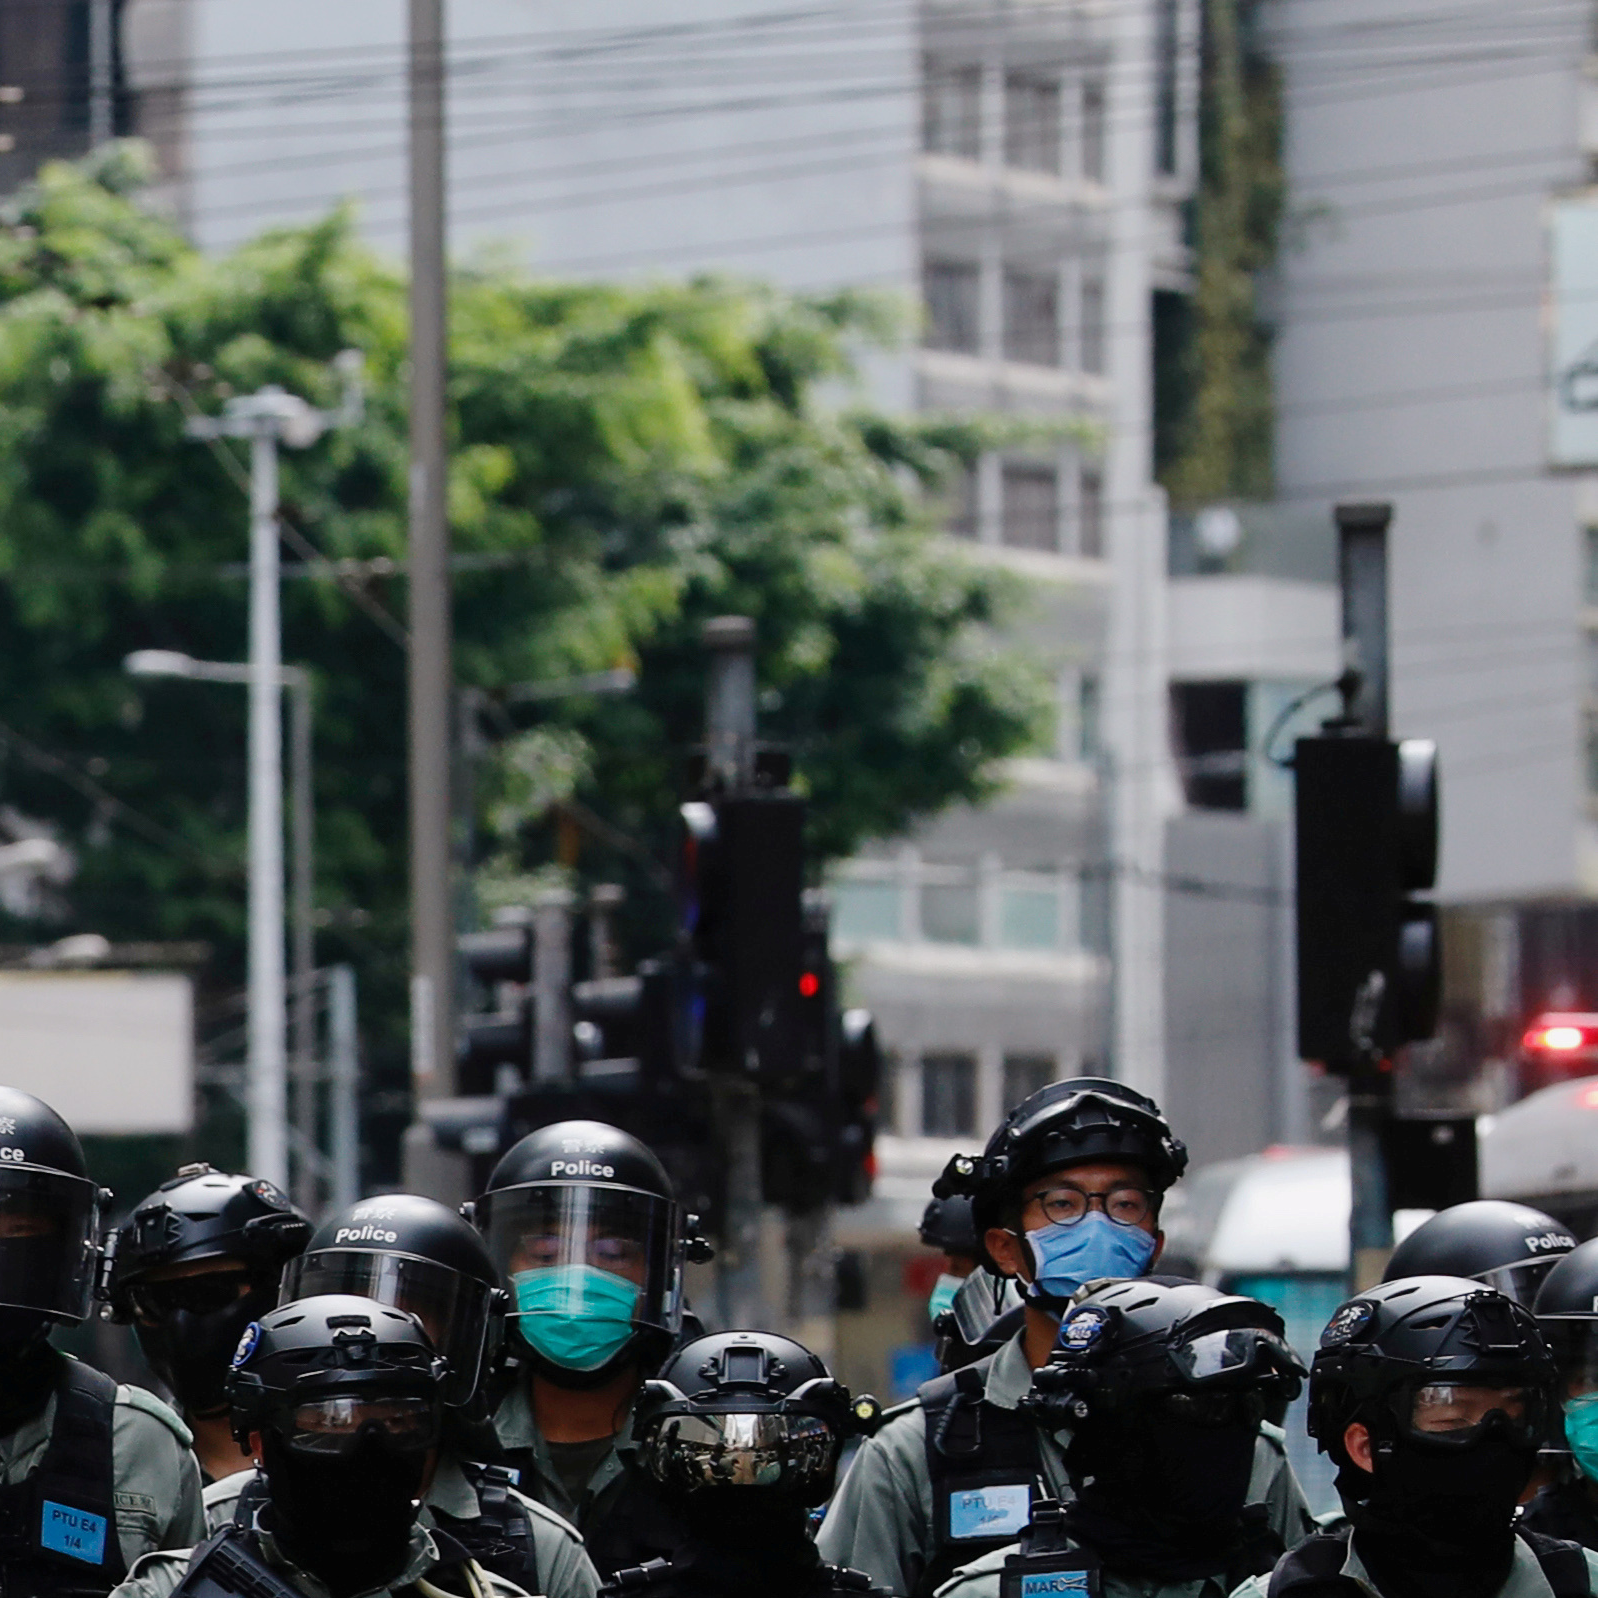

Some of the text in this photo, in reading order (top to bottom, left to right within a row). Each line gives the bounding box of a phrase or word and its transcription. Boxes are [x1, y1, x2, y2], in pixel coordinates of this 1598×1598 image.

[550, 1160, 615, 1178] Police
[335, 1224, 397, 1244] Police
[1525, 1233, 1576, 1252] Police
[52, 1510, 97, 1533] PTU E4
[64, 1534, 82, 1549] 1/4
